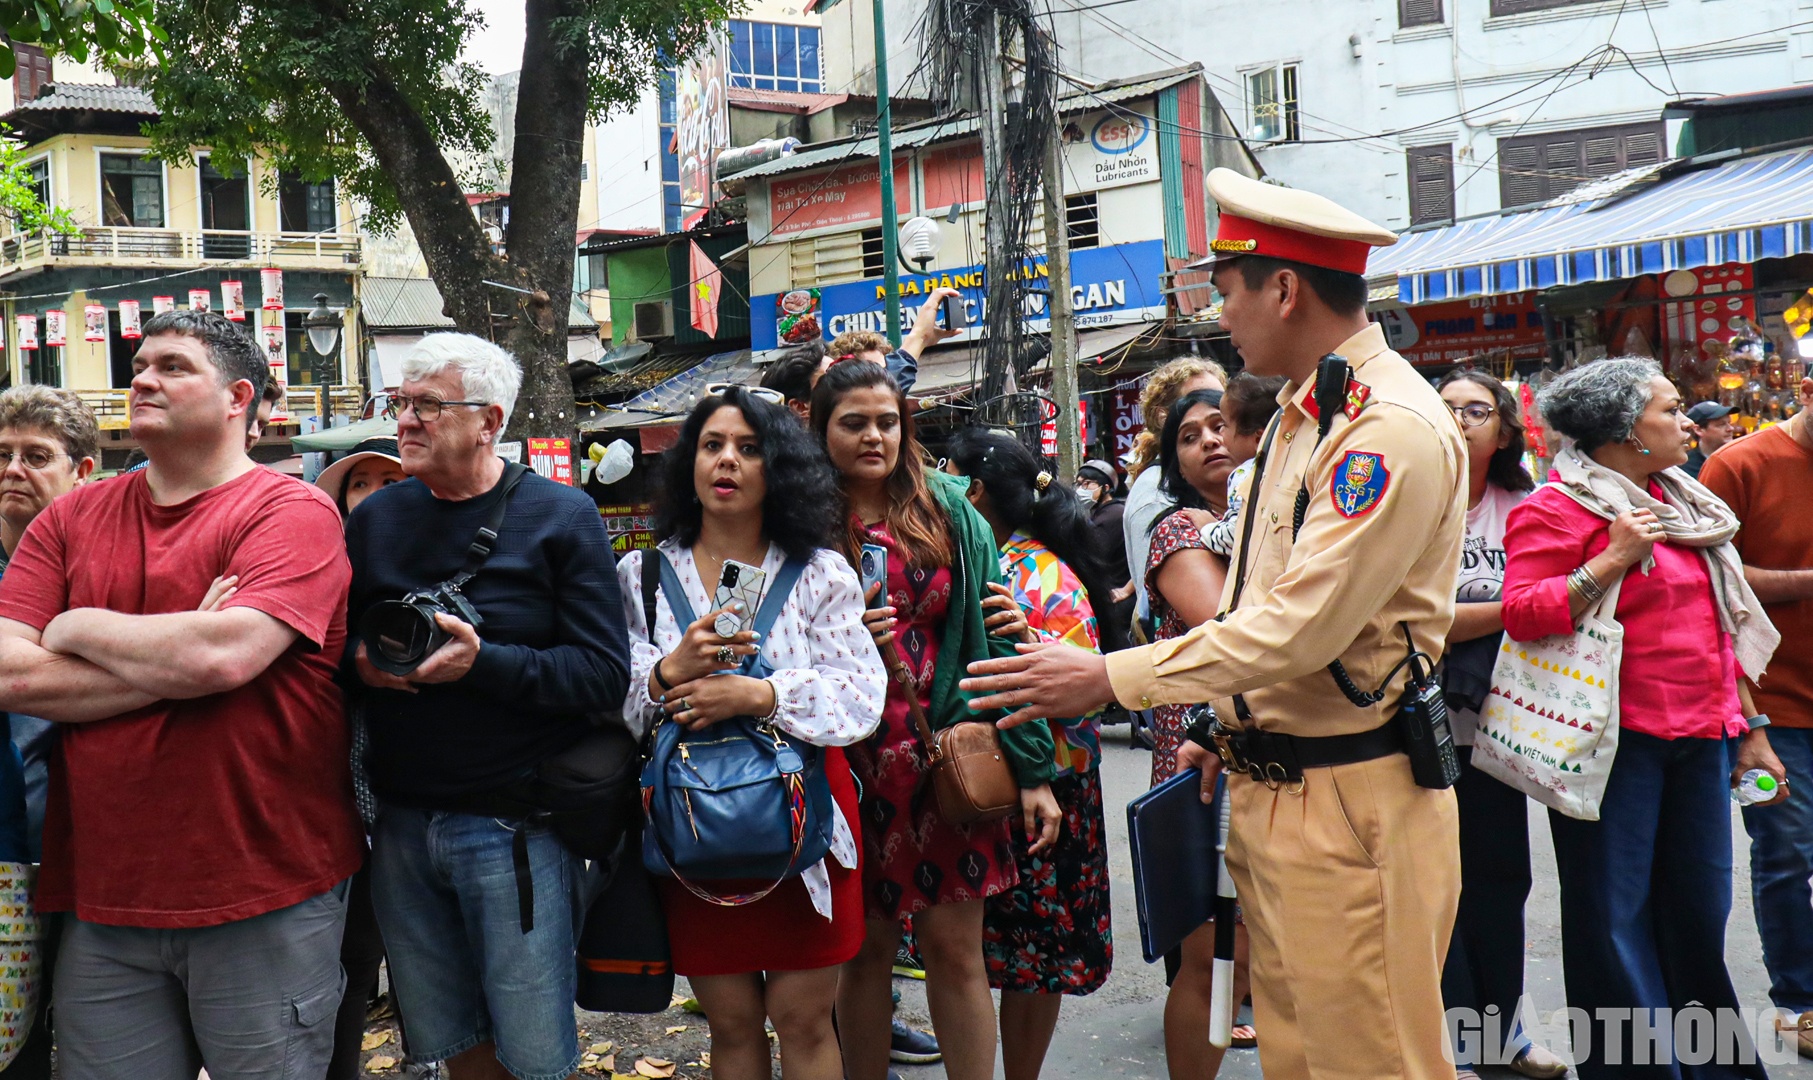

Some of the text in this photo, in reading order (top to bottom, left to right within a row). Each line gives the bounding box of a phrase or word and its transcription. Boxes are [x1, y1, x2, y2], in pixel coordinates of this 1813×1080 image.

[1096, 167, 1149, 183] Lubricants
[876, 279, 920, 299] NÀ
[924, 271, 984, 294] HÀNG
[1098, 314, 1114, 324] 187
[1336, 484, 1376, 498] CSGT
[1541, 753, 1557, 767] NAM
